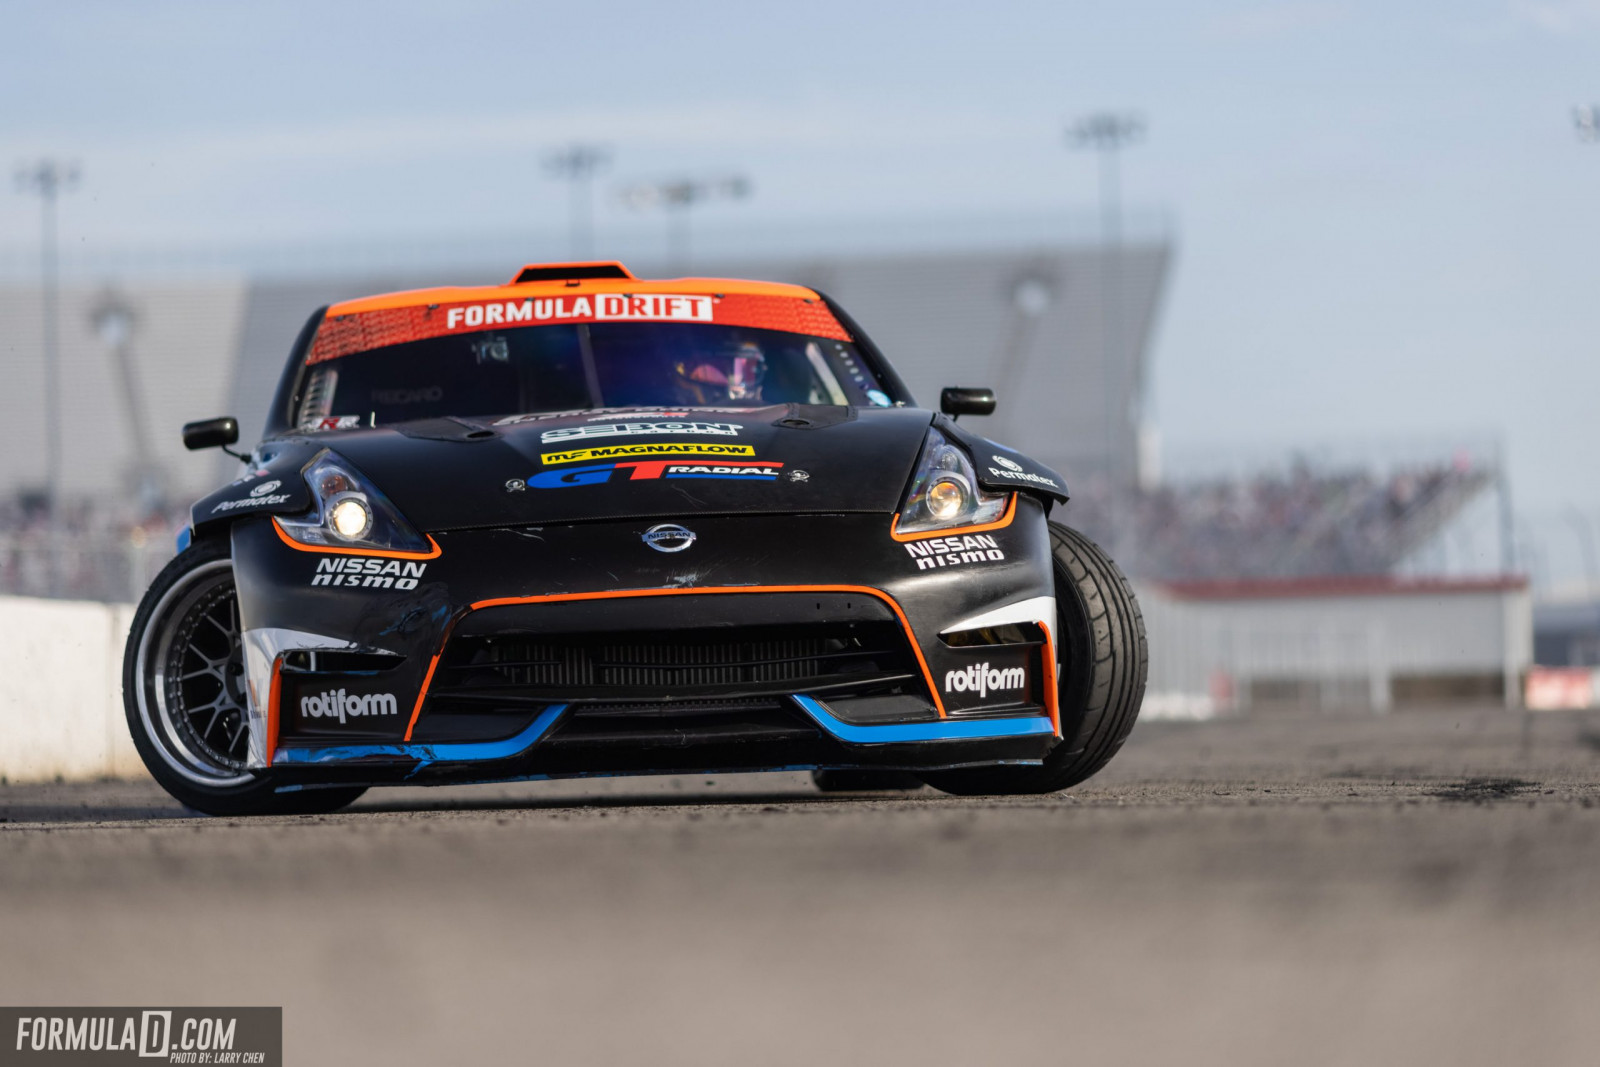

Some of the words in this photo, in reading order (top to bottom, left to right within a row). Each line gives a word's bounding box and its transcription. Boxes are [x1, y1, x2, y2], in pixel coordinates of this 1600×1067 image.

[447, 297, 592, 329] FORMULA
[602, 297, 706, 318] DRIFT
[541, 422, 734, 440] SEBON
[590, 445, 747, 457] MAGNAFLOW
[527, 461, 670, 489] GT
[668, 466, 779, 476] RADIAL
[987, 467, 1059, 489] Permatex
[211, 494, 292, 514] Permatex
[648, 531, 690, 540] NISSAN
[904, 535, 998, 558] NISSAN
[316, 558, 427, 578] NISSAN
[945, 662, 1025, 698] rotiform
[301, 688, 398, 724] rotiform
